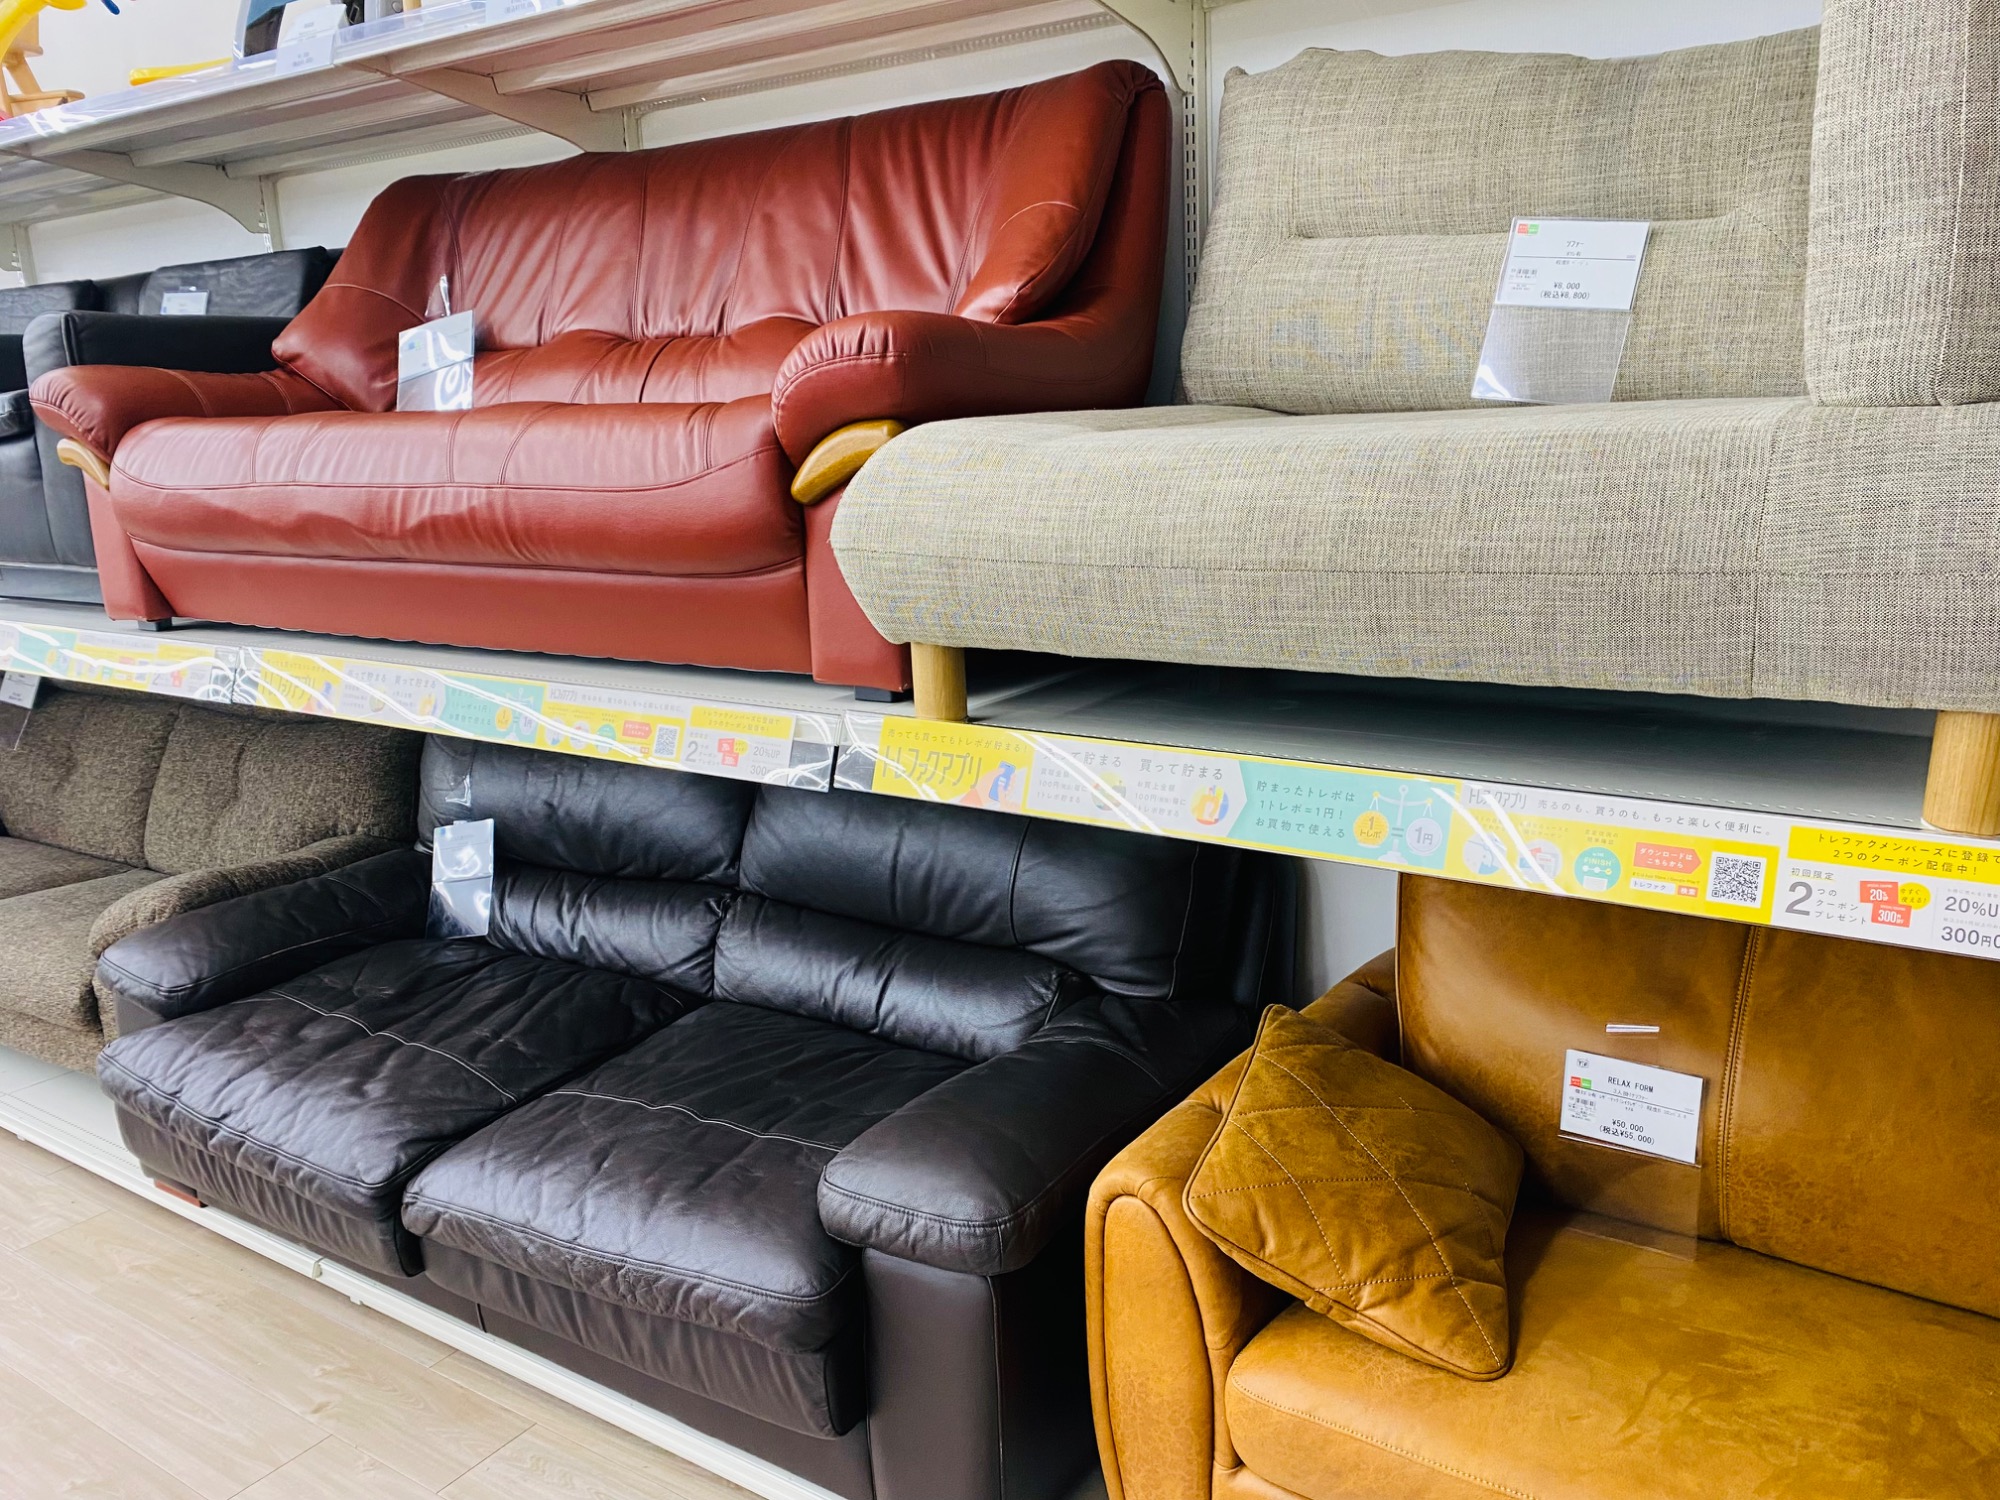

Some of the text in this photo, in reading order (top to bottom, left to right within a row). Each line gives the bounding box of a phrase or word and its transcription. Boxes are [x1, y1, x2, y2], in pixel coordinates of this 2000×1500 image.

[685, 740, 699, 763] 2
[1139, 757, 1225, 781] 買って貯まる
[1256, 780, 1356, 803] 貯まったトレポは
[1255, 817, 1346, 839] お買物で使える
[1368, 816, 1376, 830] 1
[1359, 828, 1382, 839] トレポ
[1414, 826, 1435, 846] 1円
[1583, 856, 1612, 867] FINISH
[1639, 847, 1694, 861] ダウンロードは
[1646, 857, 1684, 869] こちらから
[1791, 867, 1835, 880] 初回限定
[1633, 880, 1666, 891] トレファク
[1817, 887, 1838, 897] つの
[1785, 881, 1814, 917] 2
[1815, 898, 1859, 912] クーポン
[1814, 910, 1867, 926] プレゼント
[1607, 1076, 1654, 1093] RELAX FORM
[1611, 1118, 1645, 1133] ¥50,000
[1599, 1125, 1656, 1146] (税込¥55,000)
